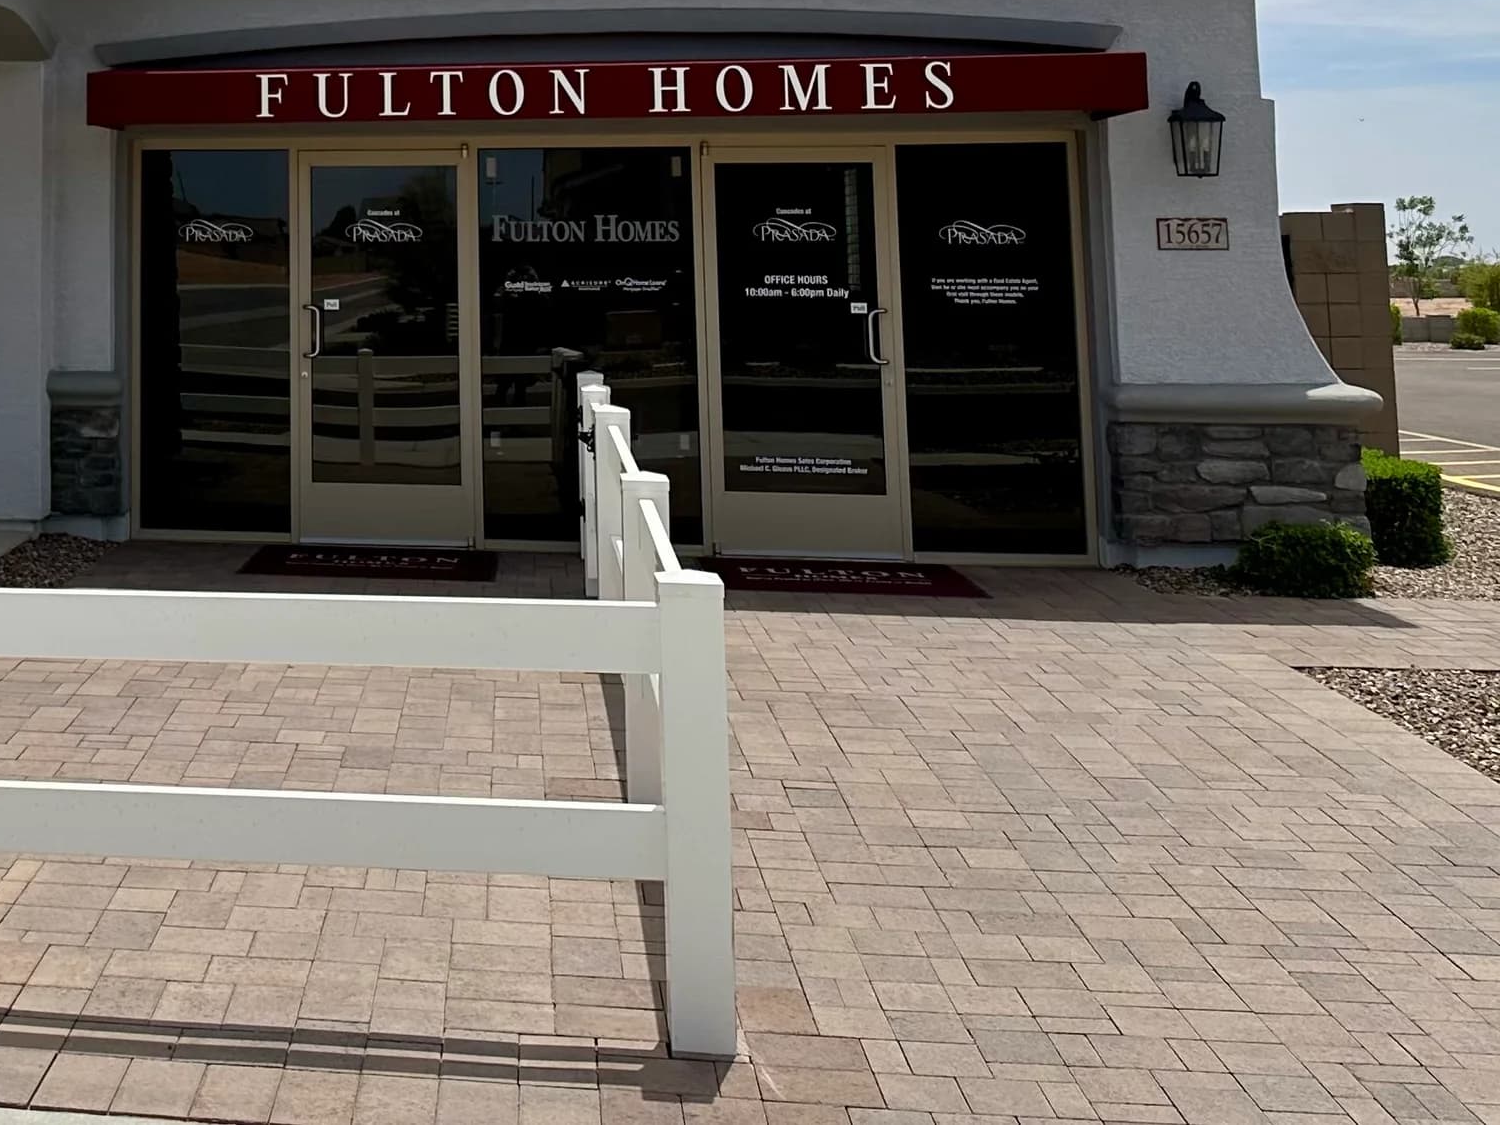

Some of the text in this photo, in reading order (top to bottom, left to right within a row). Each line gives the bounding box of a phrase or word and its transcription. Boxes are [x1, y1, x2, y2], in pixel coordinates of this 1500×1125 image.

[255, 61, 955, 118] FULTON HOMES
[185, 224, 247, 242] PRASADA
[352, 224, 415, 242] PRASADA
[491, 214, 680, 242] FULTON HOMES
[761, 224, 830, 242] PRASADA
[947, 227, 1019, 244] PRASADA
[1164, 222, 1222, 244] 15657
[764, 275, 828, 284] OFFICE HOURS
[745, 287, 782, 297] 10:00am
[791, 287, 824, 298] 6:00pm
[826, 287, 849, 299] Daily
